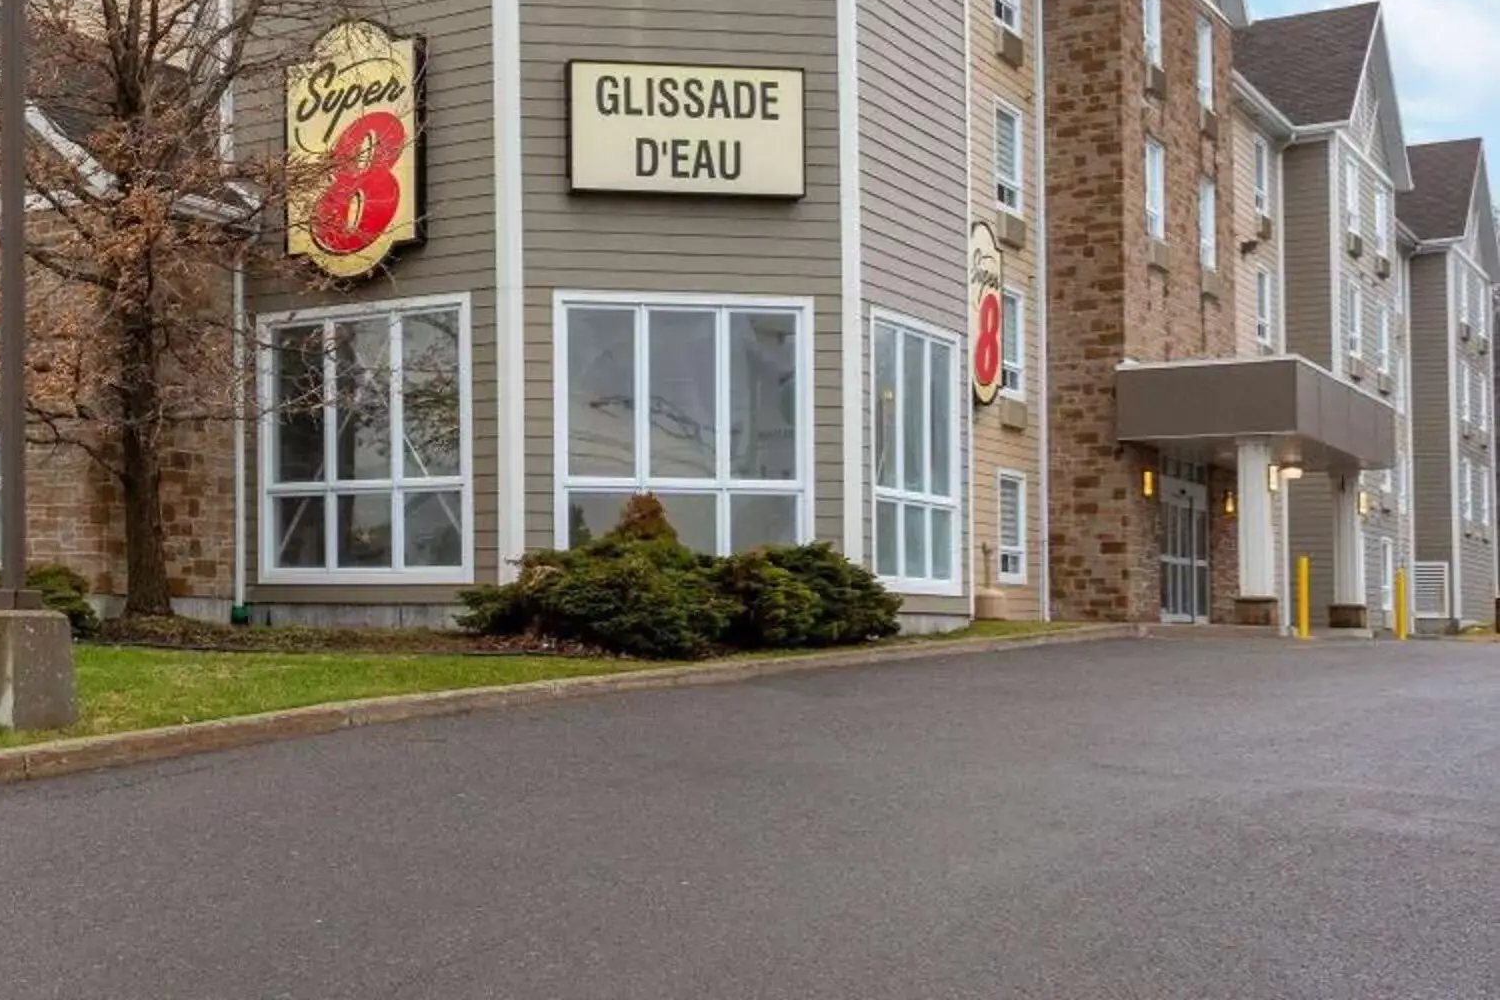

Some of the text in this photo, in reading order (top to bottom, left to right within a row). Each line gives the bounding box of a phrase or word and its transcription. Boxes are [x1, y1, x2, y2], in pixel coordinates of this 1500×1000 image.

[296, 62, 406, 143] Super
[596, 75, 779, 120] GLISSADE
[311, 111, 406, 256] 8
[636, 137, 741, 180] D'EAU
[975, 293, 999, 386] 8
